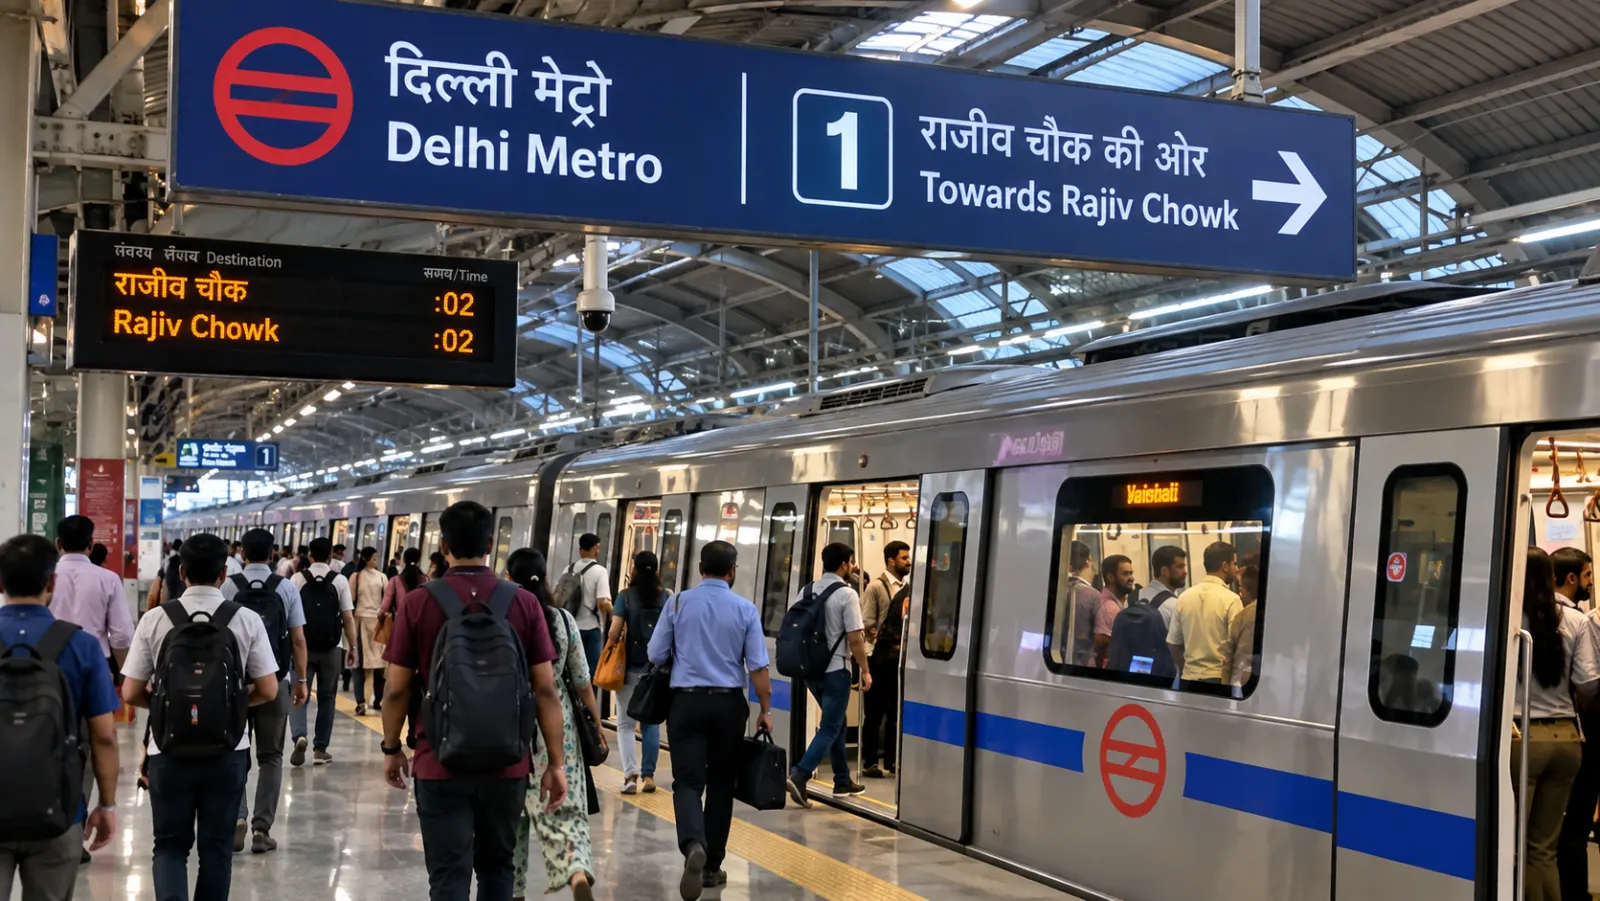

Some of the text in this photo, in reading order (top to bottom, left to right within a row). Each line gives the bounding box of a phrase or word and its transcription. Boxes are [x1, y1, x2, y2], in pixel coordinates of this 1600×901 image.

[385, 40, 613, 129] दिल्ली मेट्रो
[387, 120, 663, 184] Delhi Metro
[826, 111, 859, 191] 1
[918, 107, 1209, 178] राजीव चौक की ओर
[919, 170, 1240, 231] Towards Rajiv Chowk
[206, 251, 282, 269] Destination
[113, 266, 249, 303] राजीव चौक
[434, 291, 475, 317] :02
[113, 308, 280, 342] Rajiv Chowk
[433, 328, 474, 354] :02
[262, 448, 270, 465] 1
